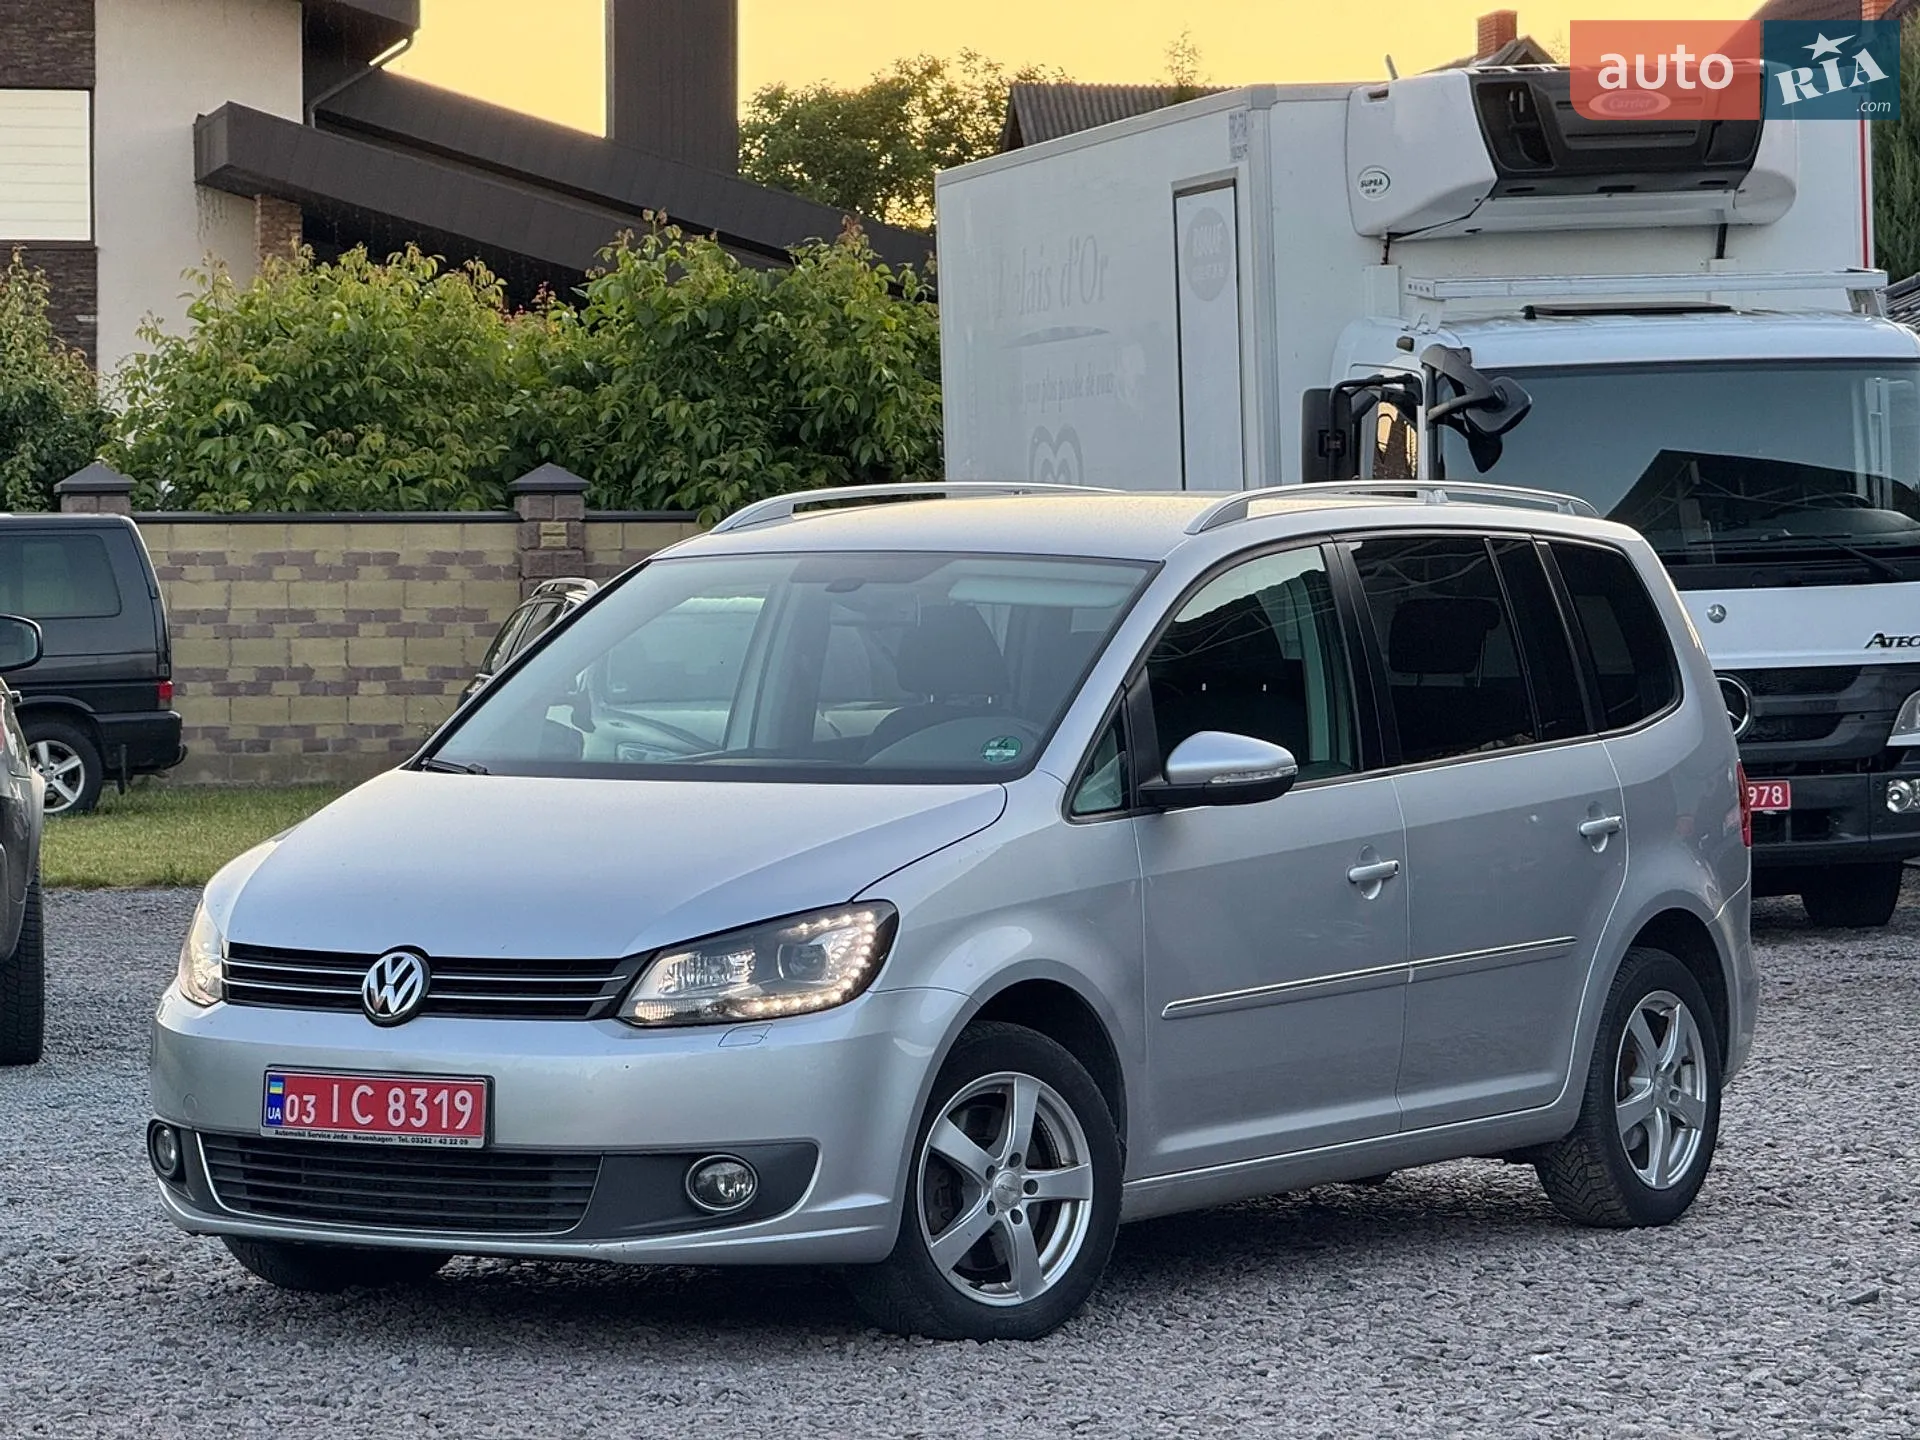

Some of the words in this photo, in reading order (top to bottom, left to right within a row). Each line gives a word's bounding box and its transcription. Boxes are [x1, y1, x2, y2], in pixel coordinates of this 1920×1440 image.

[1748, 785, 1782, 806] 978
[267, 1106, 282, 1121] UA
[285, 1094, 317, 1125] 03
[387, 1087, 473, 1130] 8319
[274, 1129, 306, 1138] Automobil
[307, 1131, 331, 1139] Service
